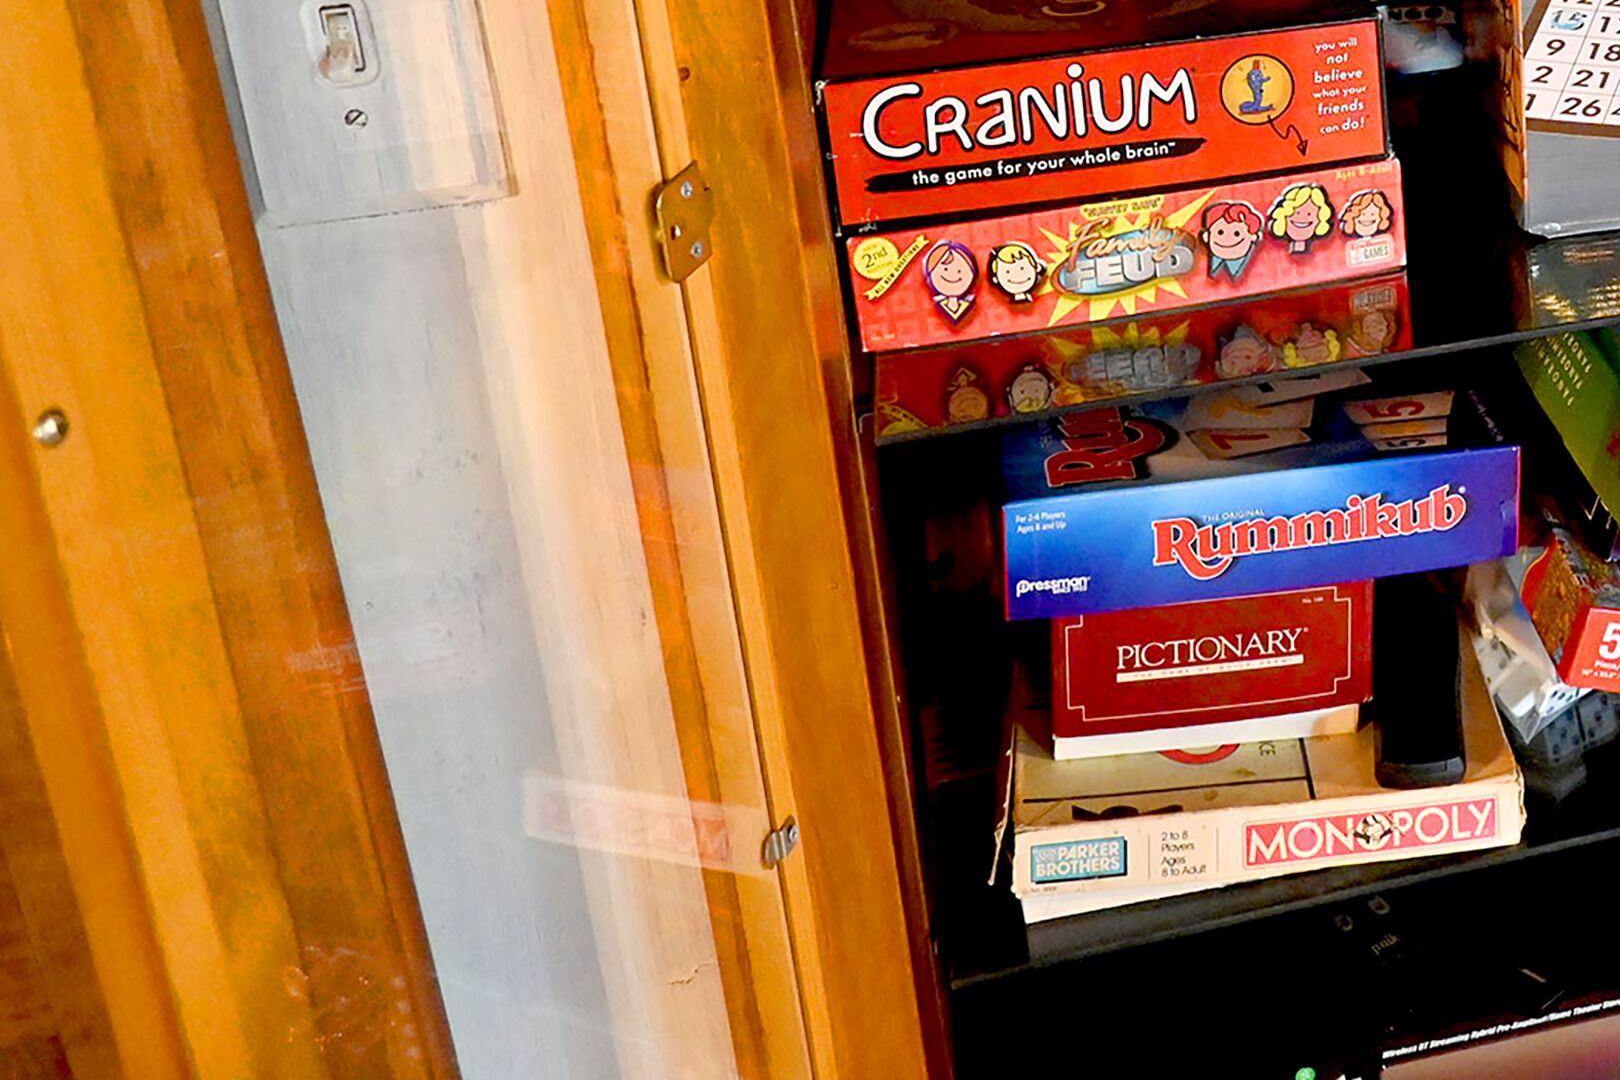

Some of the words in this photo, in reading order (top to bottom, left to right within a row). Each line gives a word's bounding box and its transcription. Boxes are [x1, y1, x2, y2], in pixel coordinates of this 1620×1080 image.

[1314, 42, 1336, 54] you
[1338, 36, 1358, 48] will
[1546, 39, 1567, 56] 9
[1326, 52, 1349, 65] not
[1313, 68, 1363, 83] believe
[1531, 65, 1553, 84] 2
[1571, 69, 1611, 89] 21
[1312, 88, 1340, 99] what
[1342, 86, 1367, 97] your
[1318, 97, 1364, 116] friends
[1560, 97, 1602, 117] 26
[1320, 124, 1340, 134] can
[1341, 116, 1365, 130] do!
[912, 170, 940, 186] the
[944, 165, 993, 185] game
[997, 160, 1022, 175] for
[1027, 157, 1066, 177] your
[1069, 149, 1122, 167] whole
[1335, 170, 1356, 182] Ages
[1066, 215, 1186, 274] Family
[1363, 245, 1389, 260] GAMES
[862, 247, 888, 269] 2nd
[1065, 245, 1195, 291] FEUD
[1015, 513, 1027, 524] For
[1041, 510, 1067, 522] Players
[1202, 513, 1220, 523] THE
[1221, 508, 1265, 521] ORIGINAL
[1017, 522, 1035, 534] Ages
[1042, 521, 1054, 531] and
[1055, 520, 1067, 532] Up
[1152, 483, 1467, 580] Rummikub
[1116, 627, 1302, 670] PICTIONARY
[1161, 831, 1168, 842] 2
[1169, 830, 1180, 841] to
[1182, 830, 1189, 839] 8
[1247, 799, 1494, 864] MONOPOLY
[1057, 841, 1120, 861] PARKER
[1161, 842, 1195, 855] Players
[1035, 856, 1121, 877] BROTHERS
[1161, 856, 1186, 868] Ages
[1161, 866, 1168, 877] 8
[1170, 866, 1180, 876] to
[1181, 864, 1207, 875] Adult
